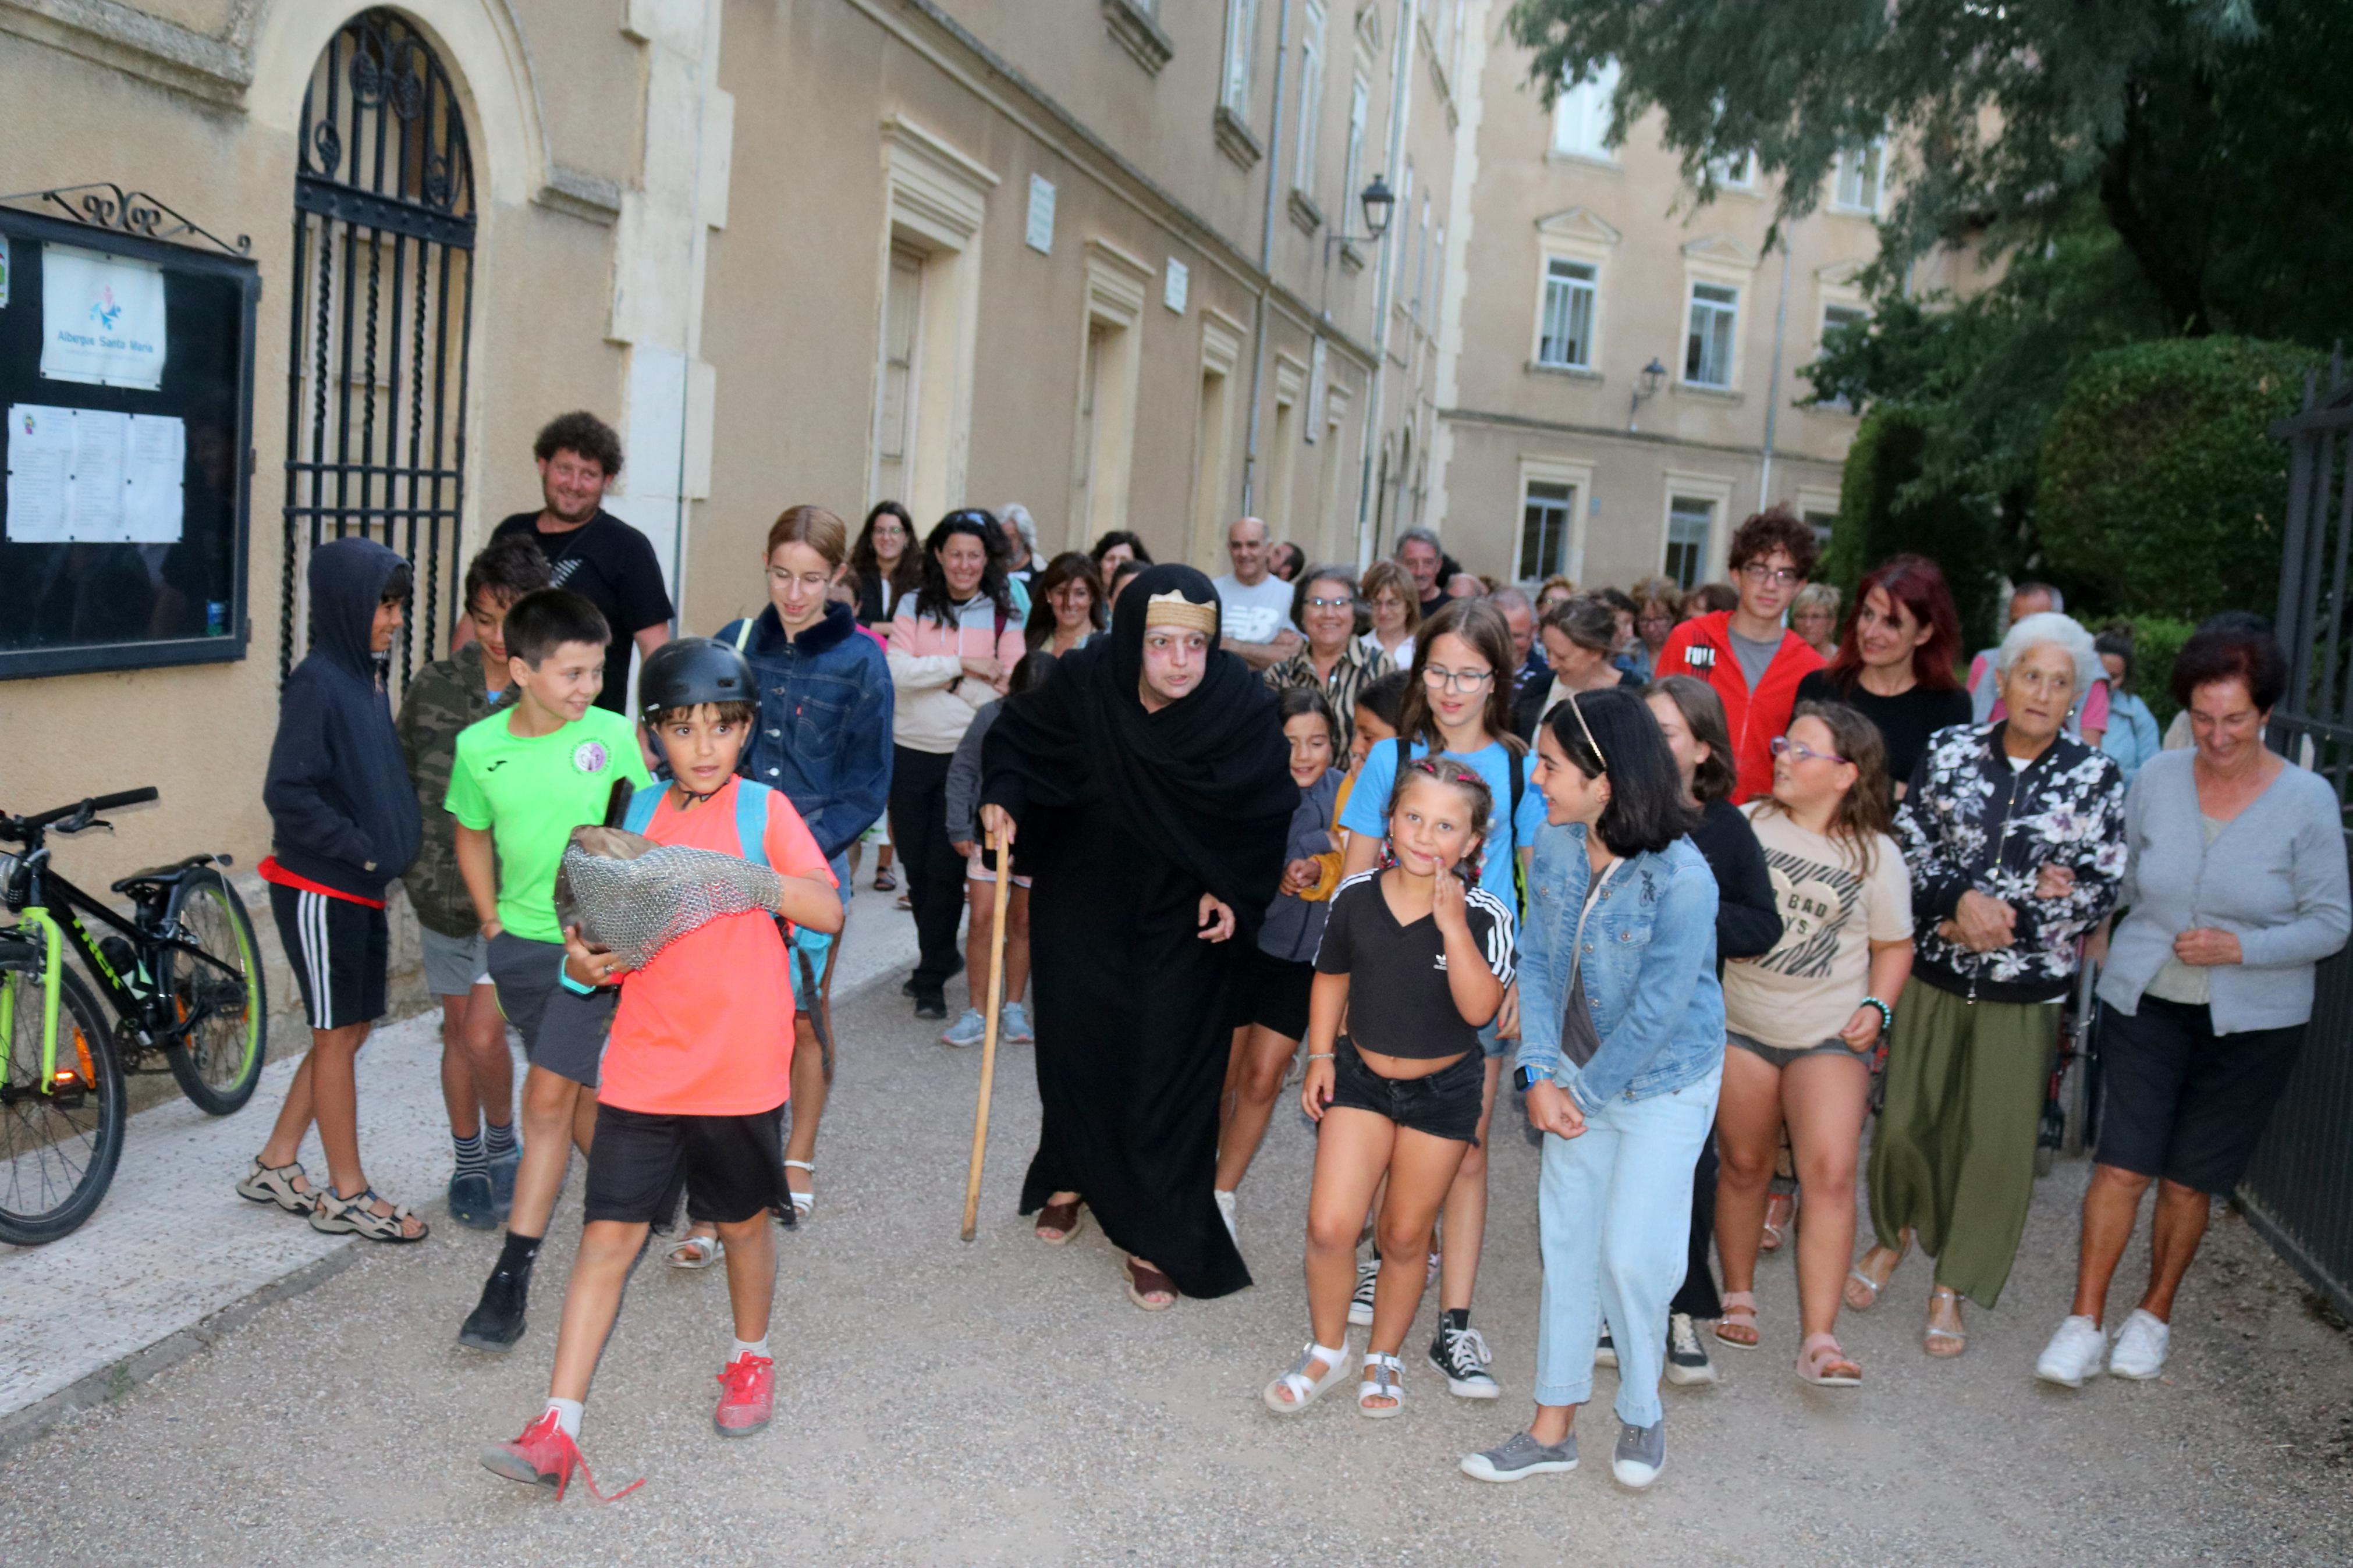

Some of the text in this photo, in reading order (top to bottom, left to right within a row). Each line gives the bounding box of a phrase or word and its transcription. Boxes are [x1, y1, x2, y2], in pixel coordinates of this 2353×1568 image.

[58, 330, 95, 346] Albergue
[98, 336, 126, 349] Santa
[1788, 894, 1827, 918] BAD
[72, 918, 125, 990] TREK
